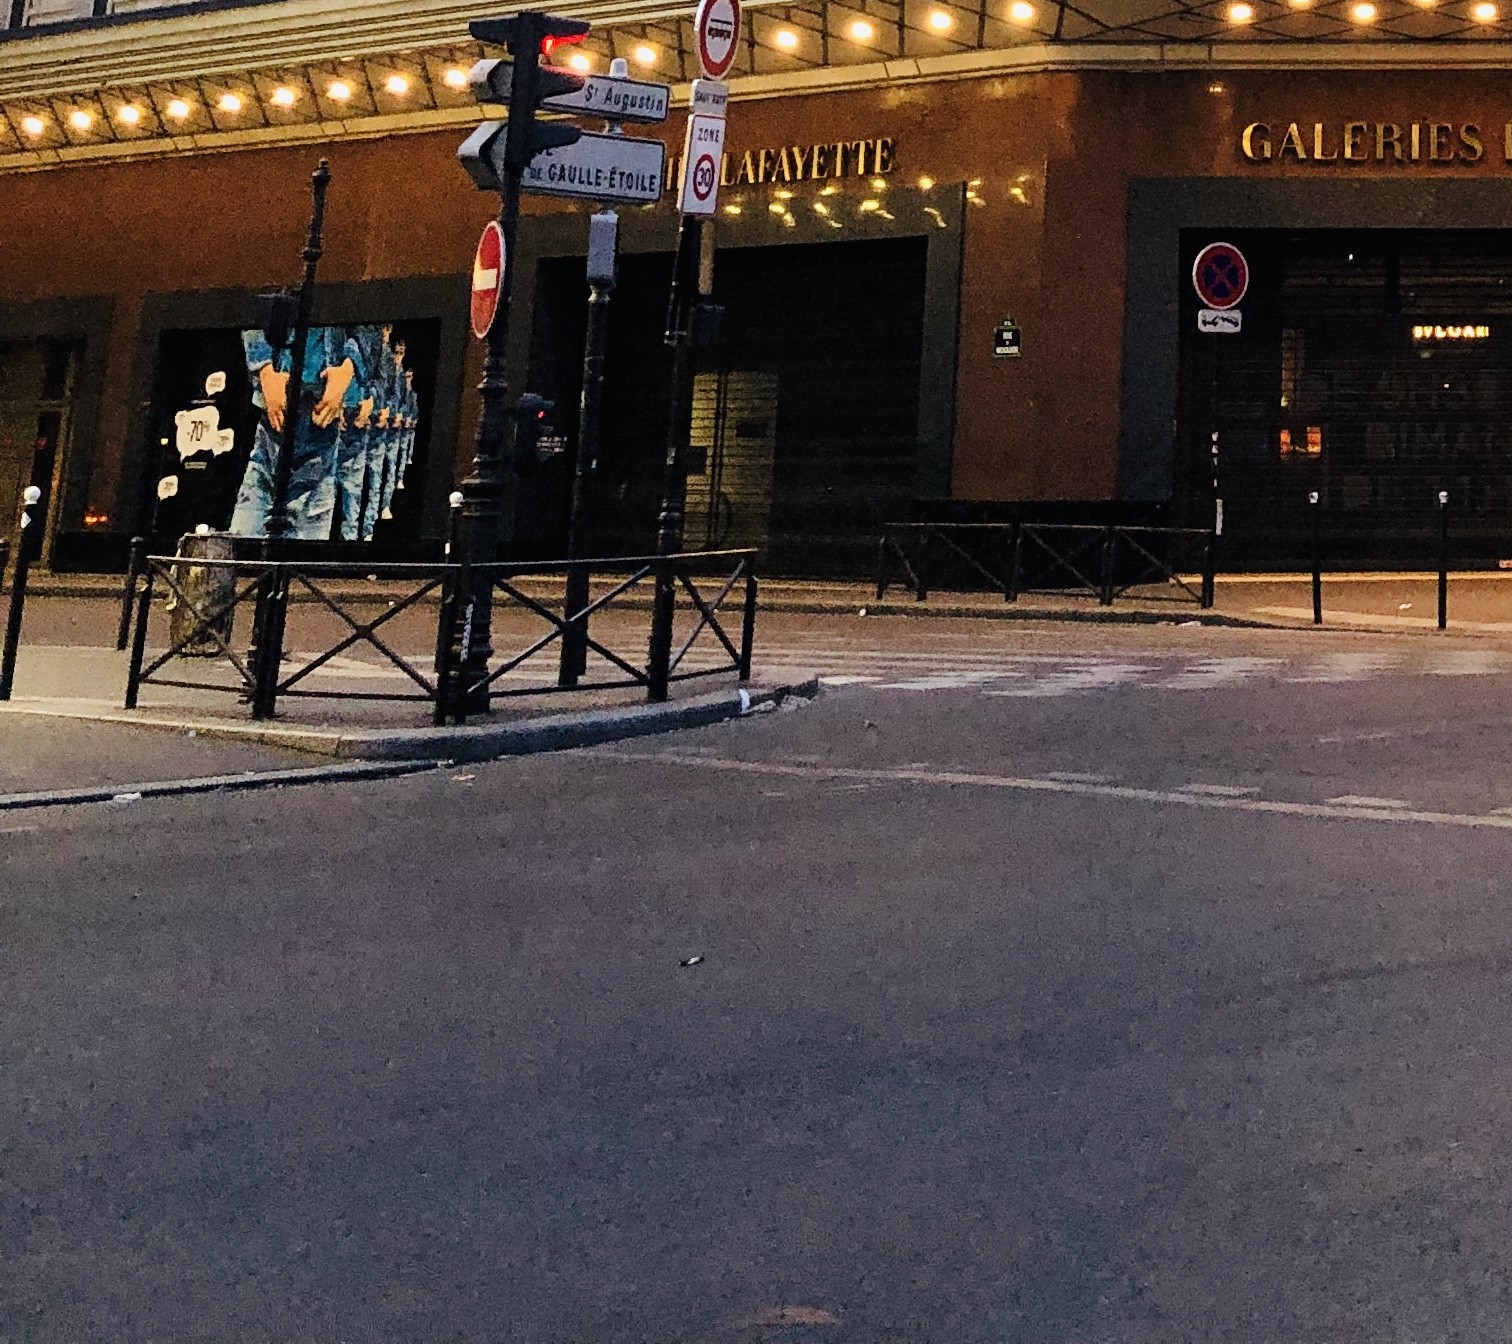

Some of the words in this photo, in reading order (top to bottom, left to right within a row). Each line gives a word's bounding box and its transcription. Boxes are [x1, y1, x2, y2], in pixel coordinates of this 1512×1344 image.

[604, 86, 663, 112] Augustin
[697, 127, 720, 143] ZONE
[1241, 122, 1485, 162] GALERIES
[720, 137, 895, 187] LAFAYETTE
[548, 162, 657, 192] GAULLE-ÉTOILE
[697, 167, 712, 187] 30
